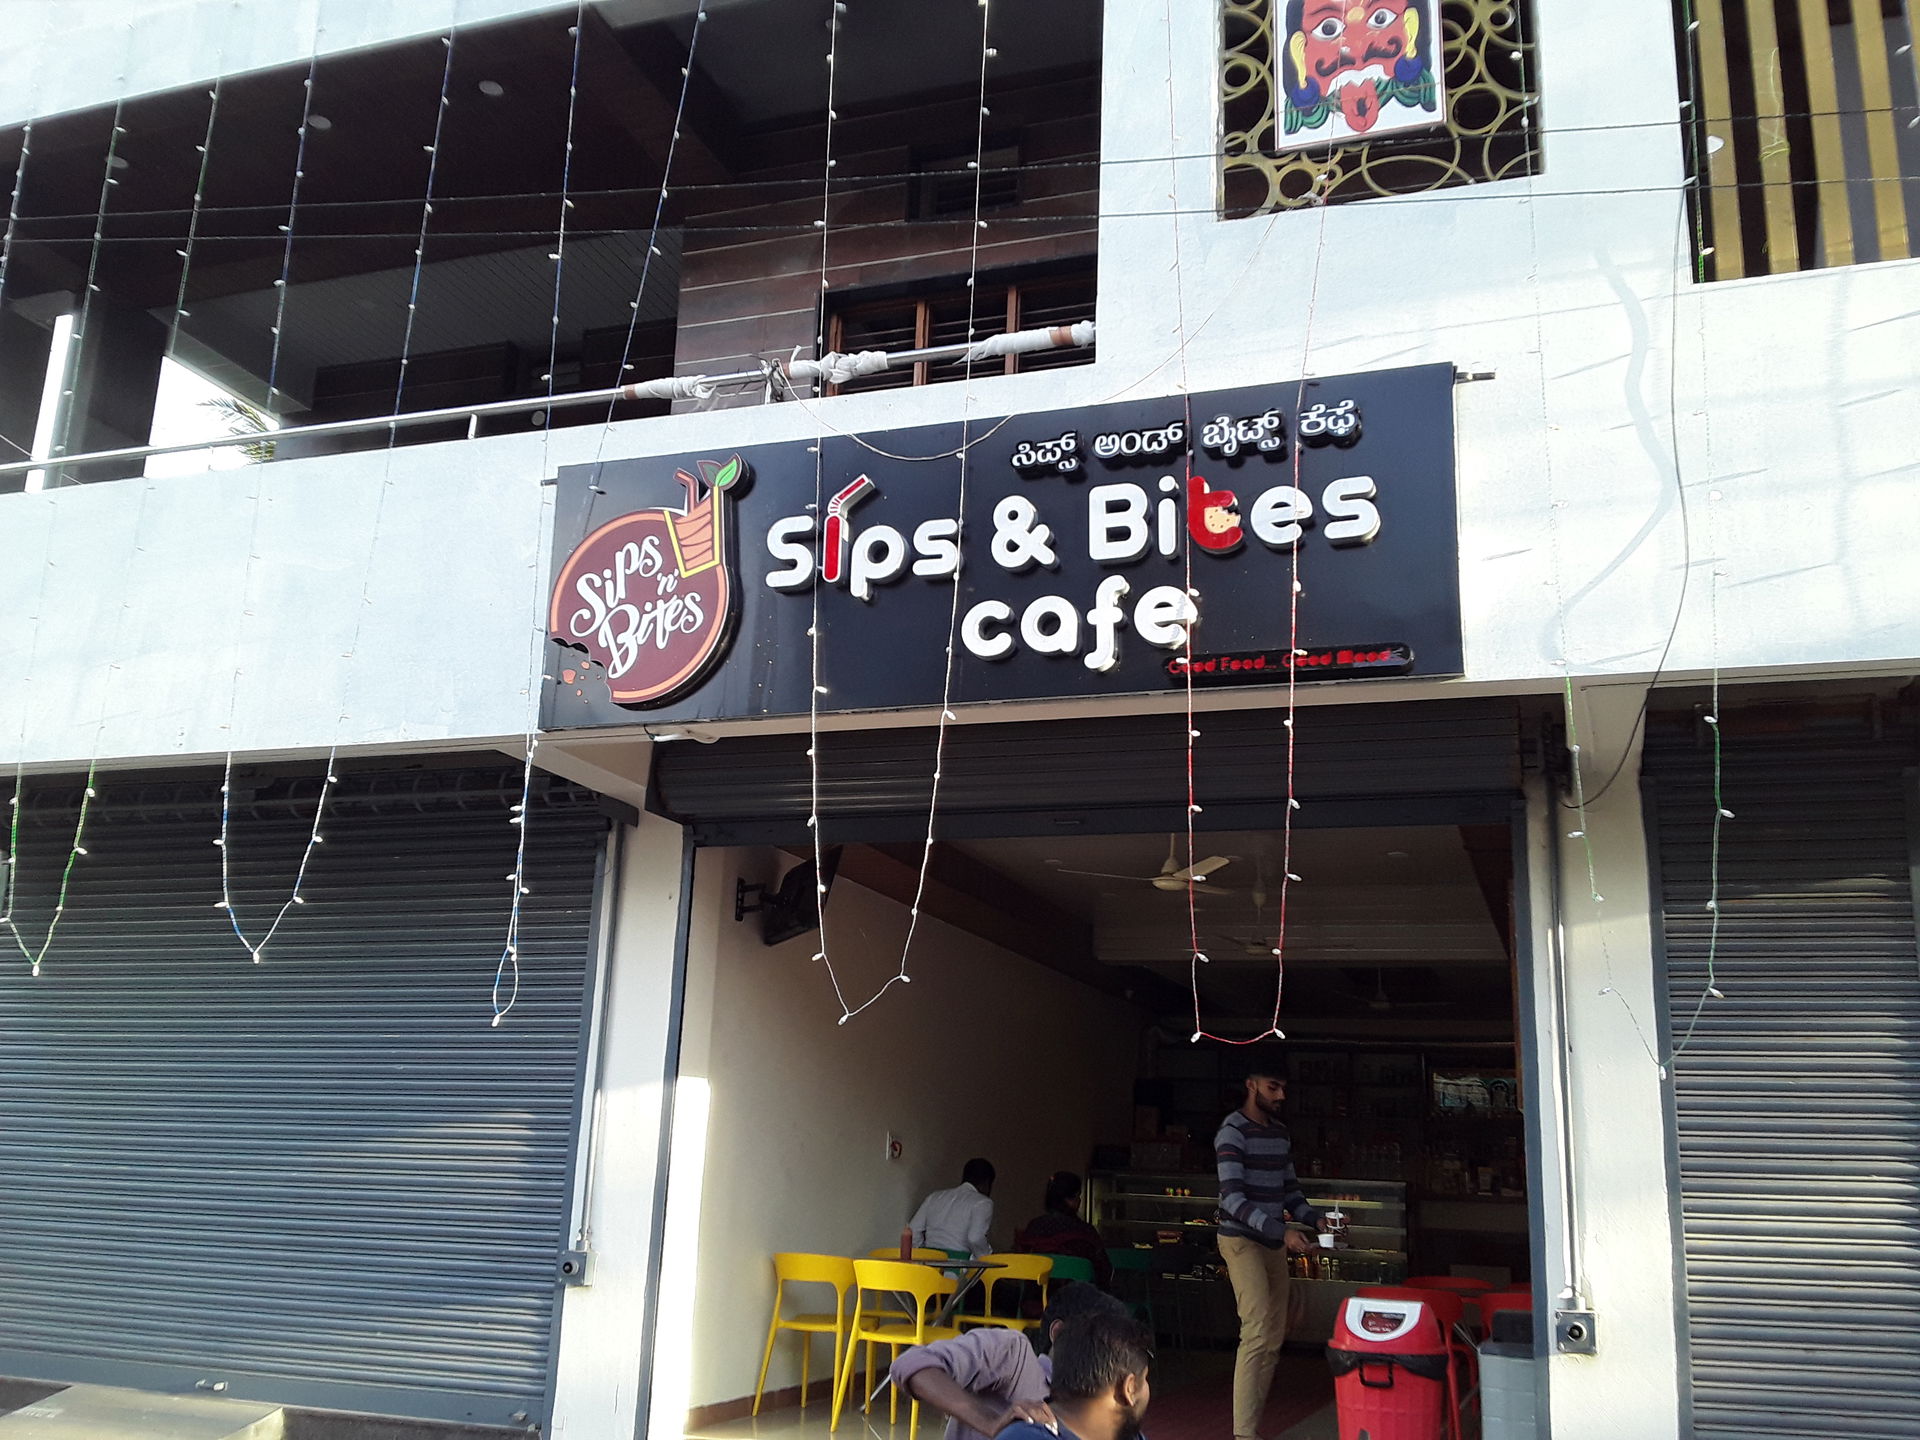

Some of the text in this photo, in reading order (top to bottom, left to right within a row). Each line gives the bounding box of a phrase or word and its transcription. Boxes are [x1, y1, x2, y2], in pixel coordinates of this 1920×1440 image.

[991, 496, 1055, 569] &
[1089, 475, 1381, 561] Bites
[570, 535, 663, 638] Sips
[961, 574, 1199, 673] cafe
[597, 592, 704, 679] Bites
